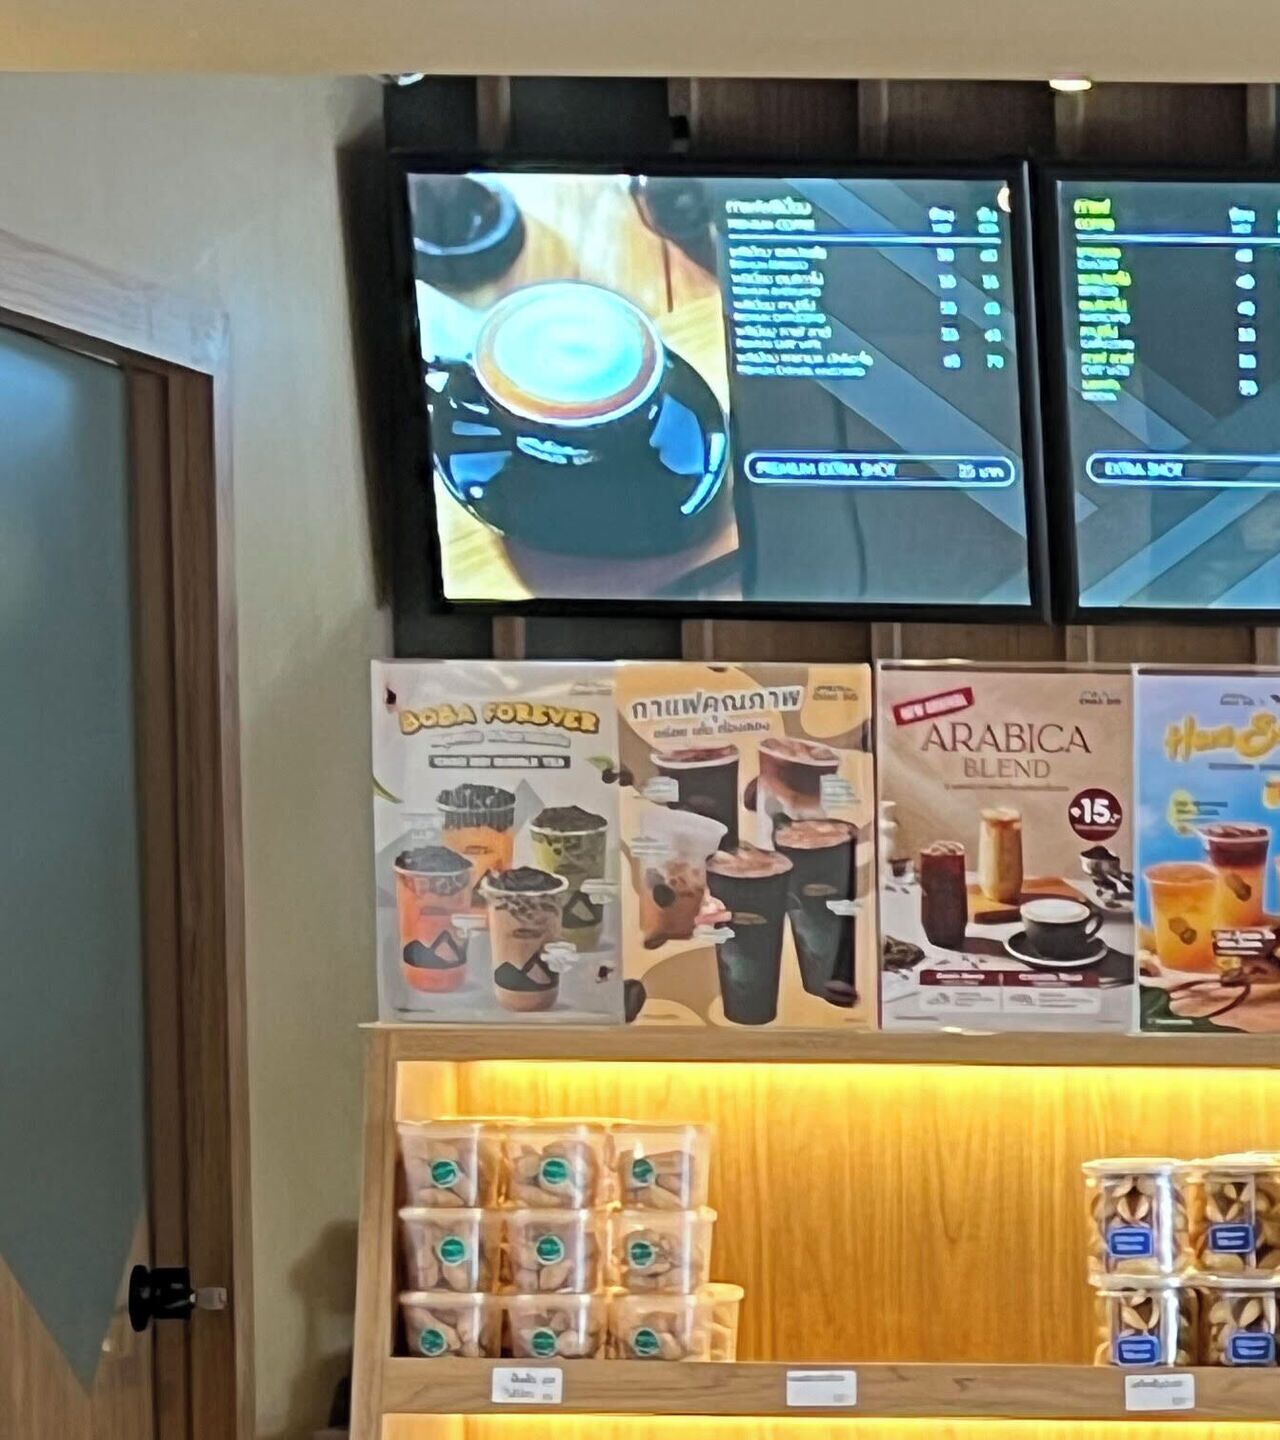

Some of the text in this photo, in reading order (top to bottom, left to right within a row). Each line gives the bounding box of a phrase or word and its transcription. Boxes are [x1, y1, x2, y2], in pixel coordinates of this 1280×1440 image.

[482, 702, 600, 734] FOREVER
[631, 688, 801, 724] กาแฟคุณภาพ
[921, 722, 1093, 754] ARABICA
[963, 756, 1052, 779] BLEND
